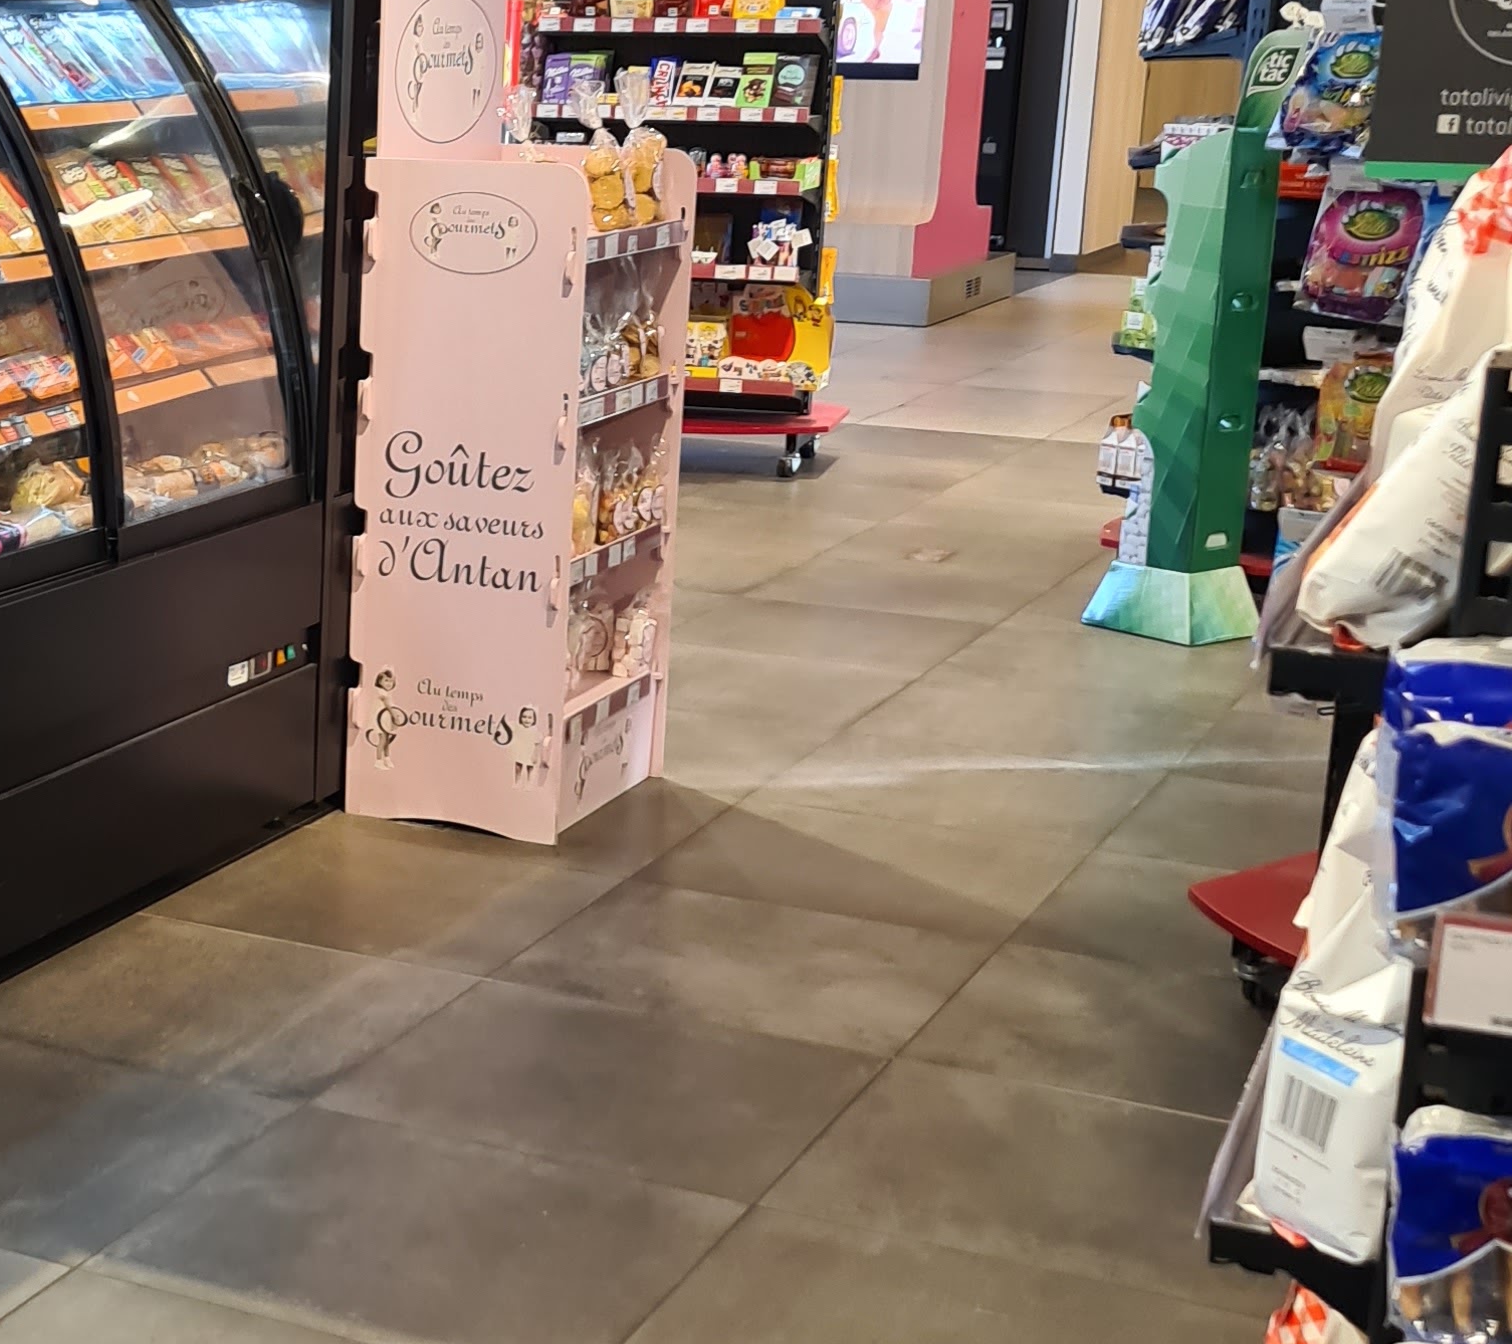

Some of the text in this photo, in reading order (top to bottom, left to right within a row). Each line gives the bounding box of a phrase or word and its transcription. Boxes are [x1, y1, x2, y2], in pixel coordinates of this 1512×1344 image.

[1259, 66, 1288, 83] tac
[1268, 50, 1294, 70] tic
[384, 430, 535, 498] Goûtez
[379, 507, 544, 540] aux saveurs
[378, 535, 543, 593] d'Antan
[416, 677, 441, 696] Au
[365, 706, 514, 748] Gourmets
